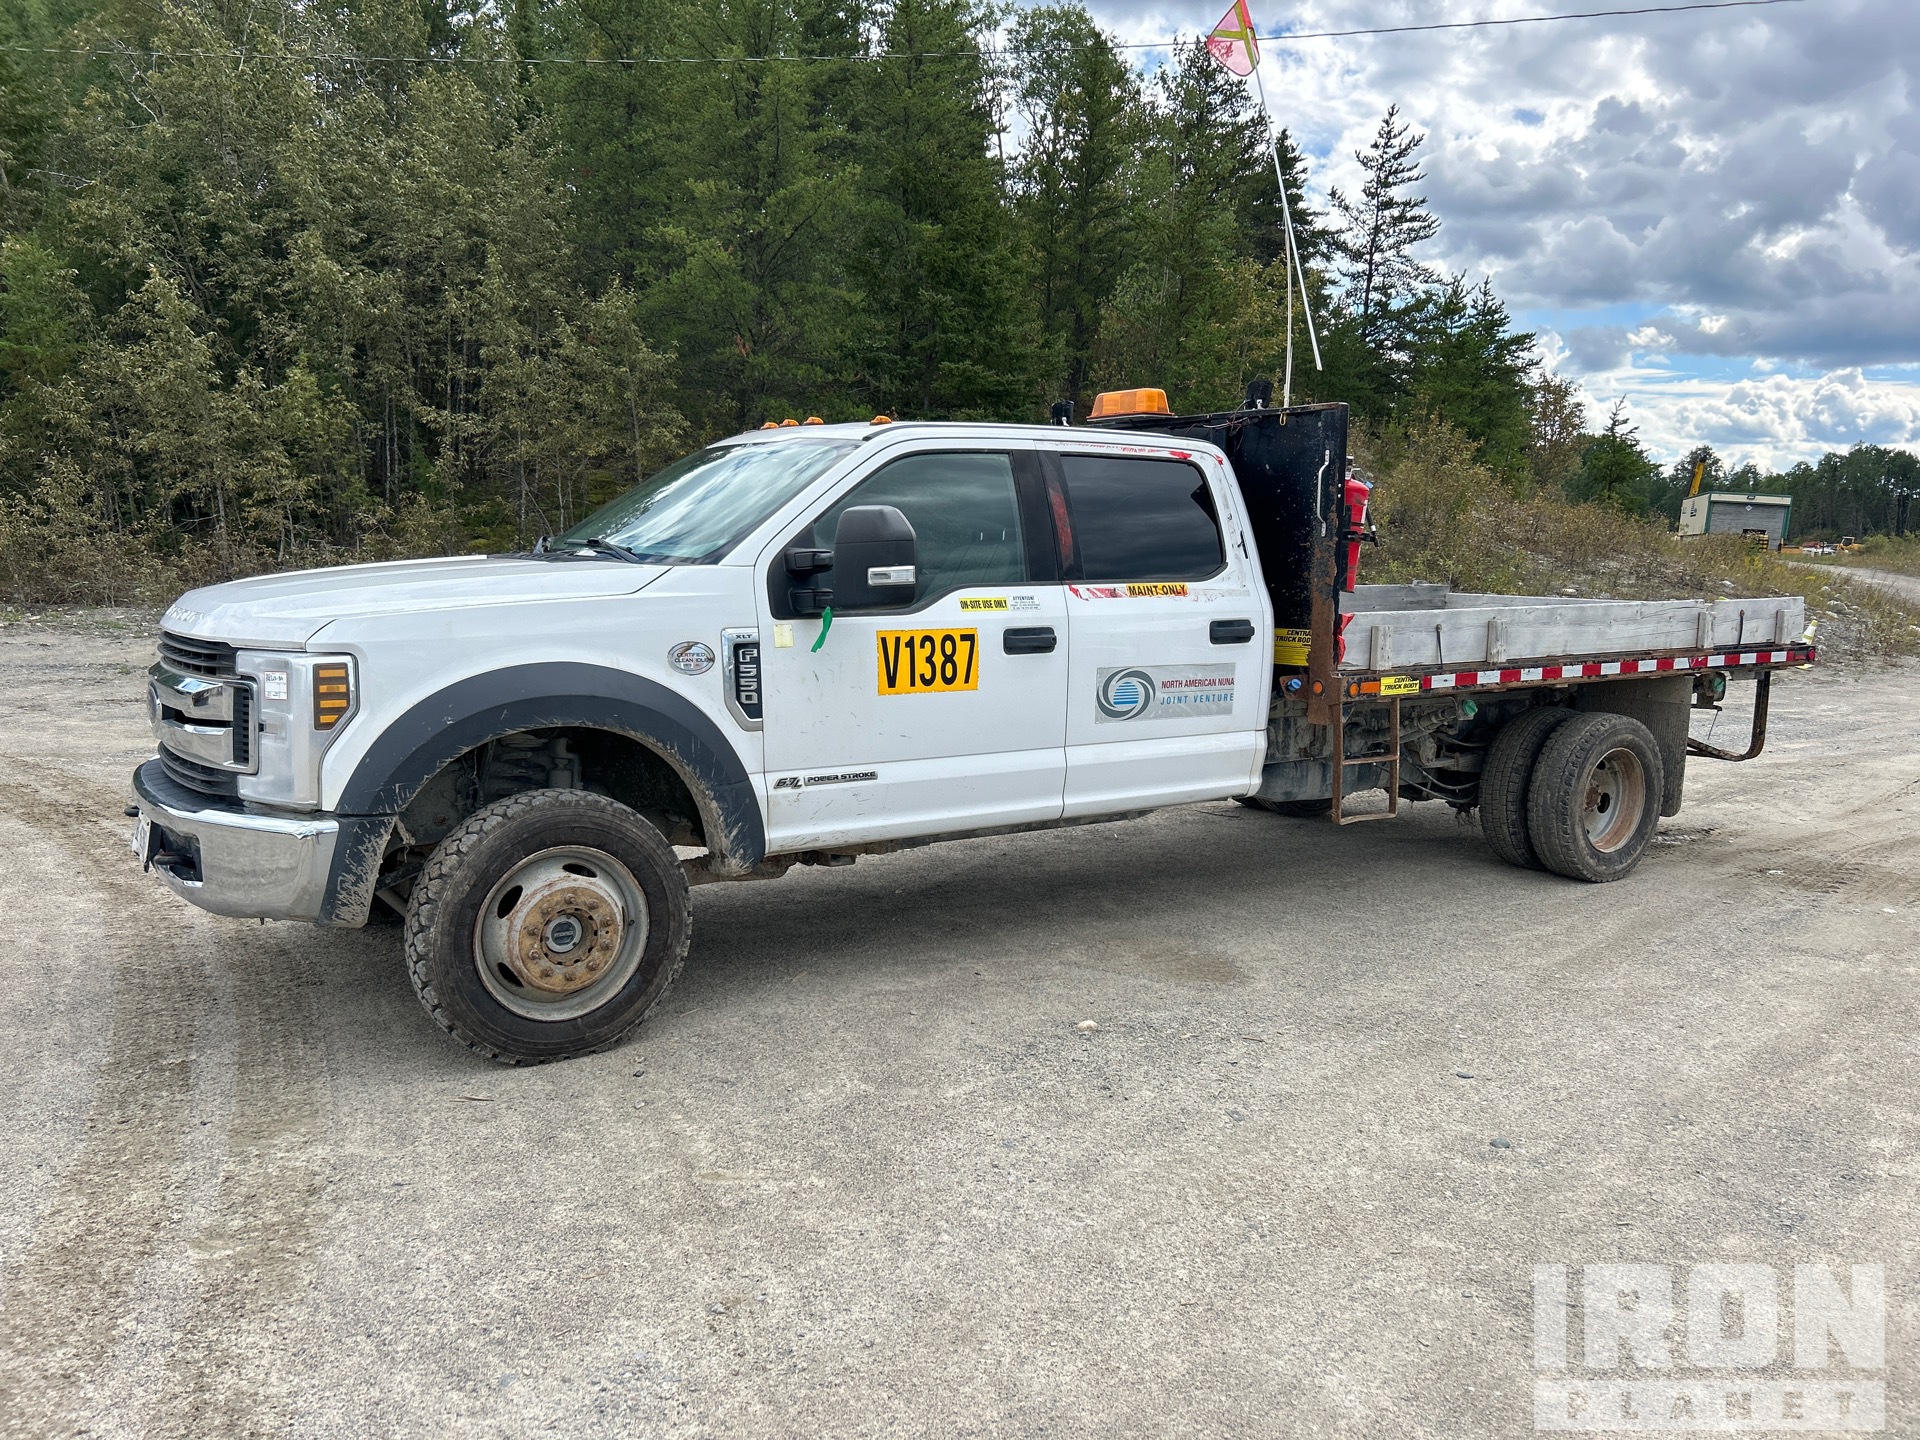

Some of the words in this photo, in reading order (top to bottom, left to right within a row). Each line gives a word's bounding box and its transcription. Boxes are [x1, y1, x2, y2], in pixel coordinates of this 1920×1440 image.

[1128, 585, 1159, 596] MAINT
[1162, 584, 1187, 596] ONLY
[960, 600, 982, 609] ON-SITE
[982, 600, 993, 609] USE
[994, 599, 1008, 608] ONLY
[880, 633, 976, 689] V1387
[1161, 680, 1183, 689] NORTH
[1184, 678, 1216, 688] AMERICAN
[1217, 677, 1235, 686] NUNA
[1160, 696, 1188, 705] JOINT
[1194, 693, 1234, 703] VENTURE
[774, 777, 802, 789] 6.7L
[807, 775, 839, 783] POWER
[840, 771, 876, 780] STROKE
